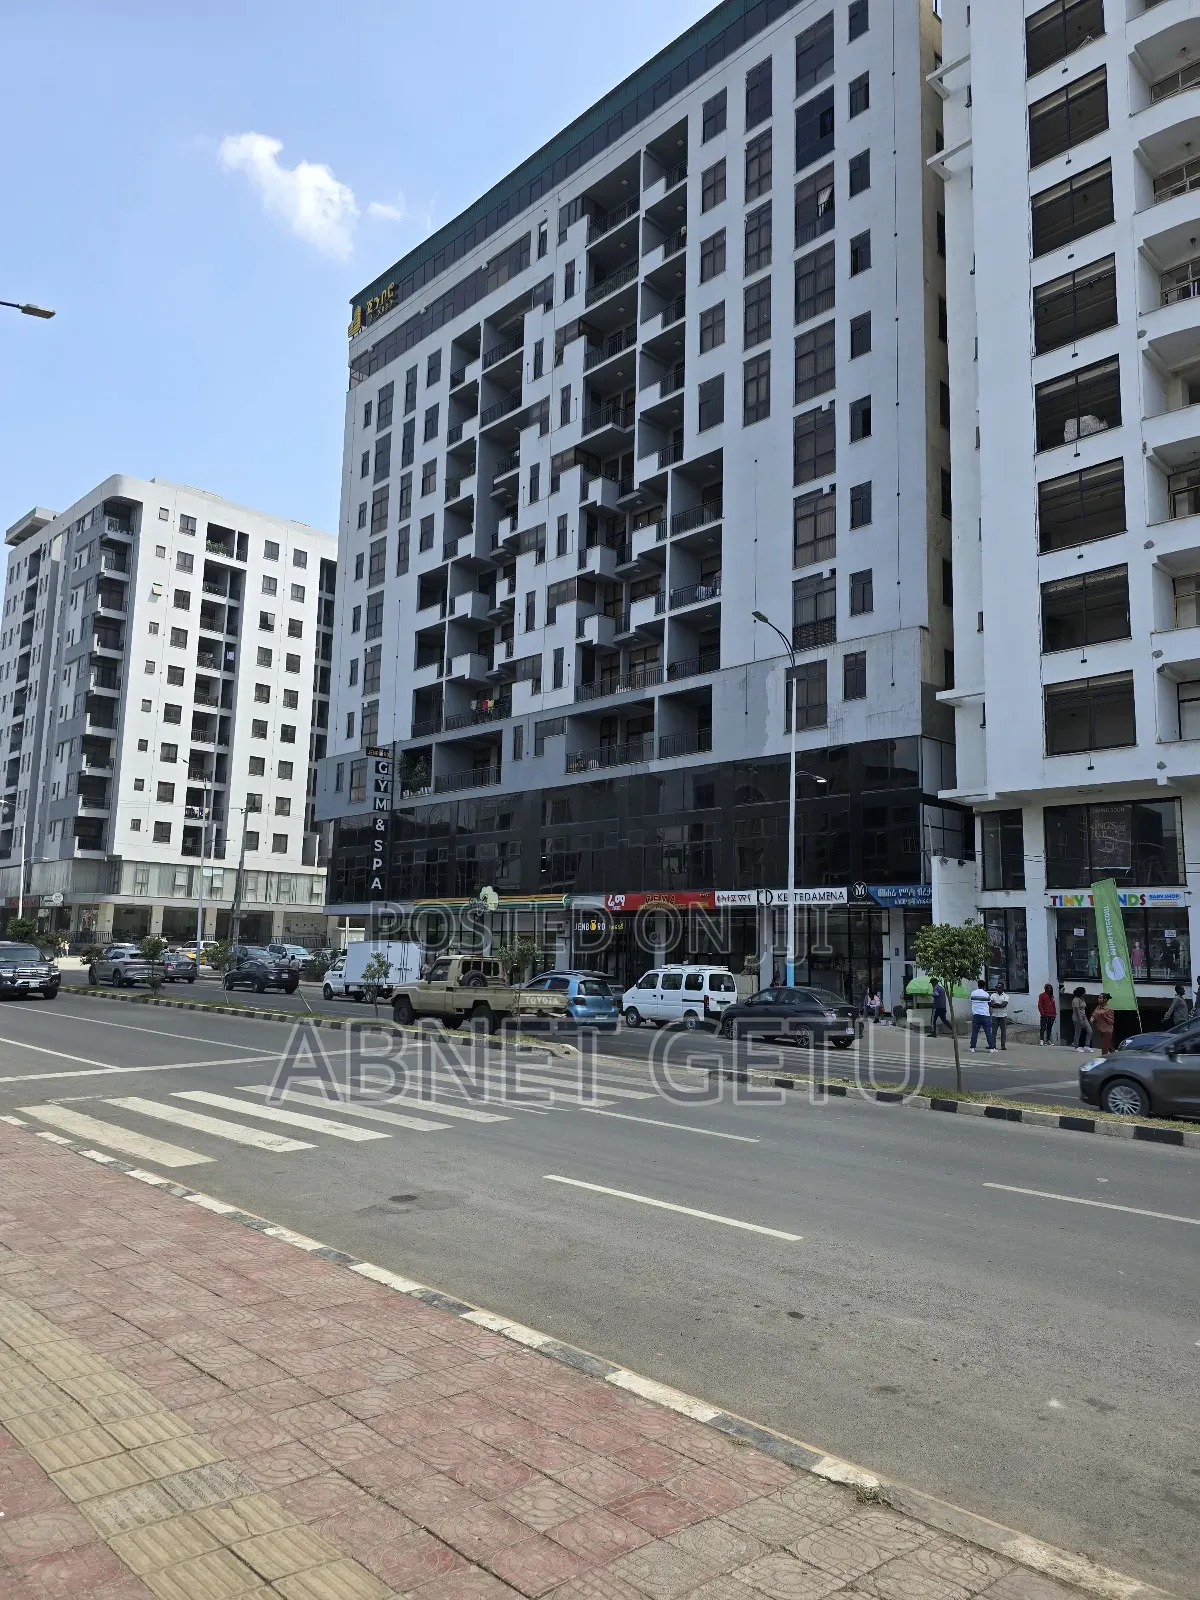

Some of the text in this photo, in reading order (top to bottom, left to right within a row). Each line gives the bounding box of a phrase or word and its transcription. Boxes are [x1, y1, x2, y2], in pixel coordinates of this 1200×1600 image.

[370, 762, 388, 890] GYM & SPA
[777, 891, 845, 902] KETEDAMENA
[1050, 894, 1085, 907] TINY
[1088, 893, 1147, 907] TNDS
[525, 996, 559, 1005] TOYOTA
